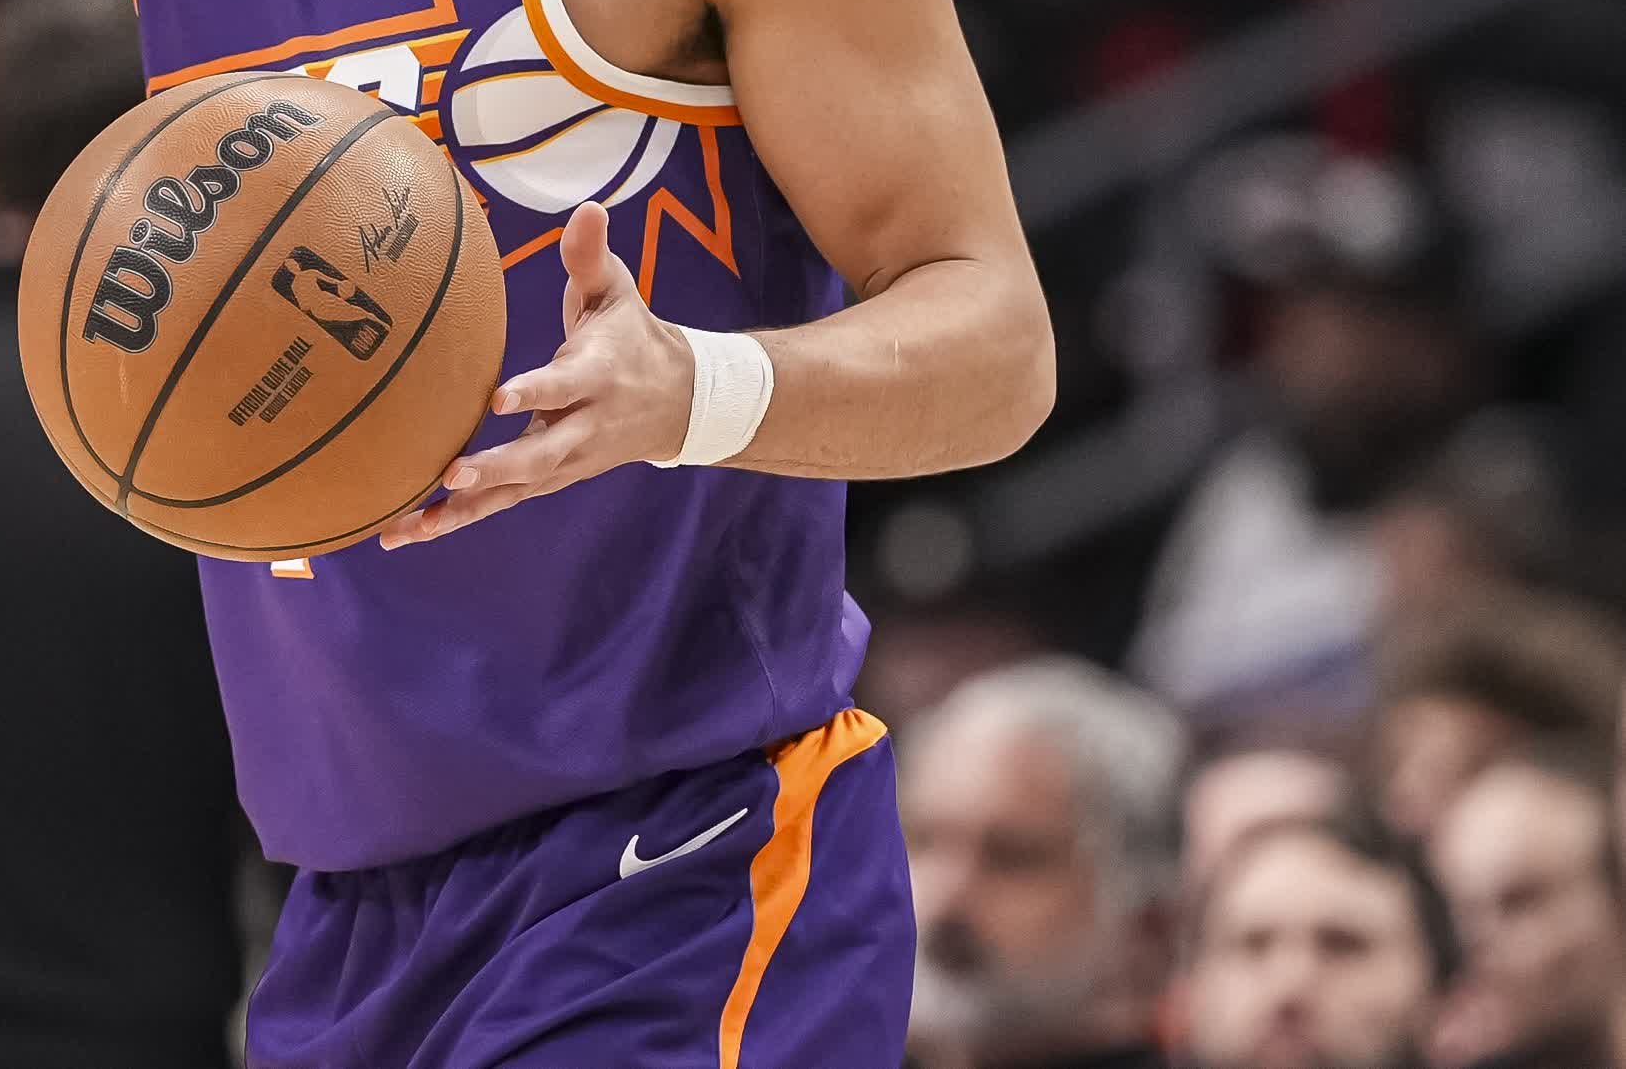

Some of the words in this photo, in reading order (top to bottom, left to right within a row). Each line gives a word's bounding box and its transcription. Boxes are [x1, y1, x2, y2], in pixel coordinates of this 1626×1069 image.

[82, 99, 329, 355] Wilson
[228, 384, 272, 427] OFFICIAL
[261, 357, 294, 391] GAME
[283, 335, 313, 366] BALL
